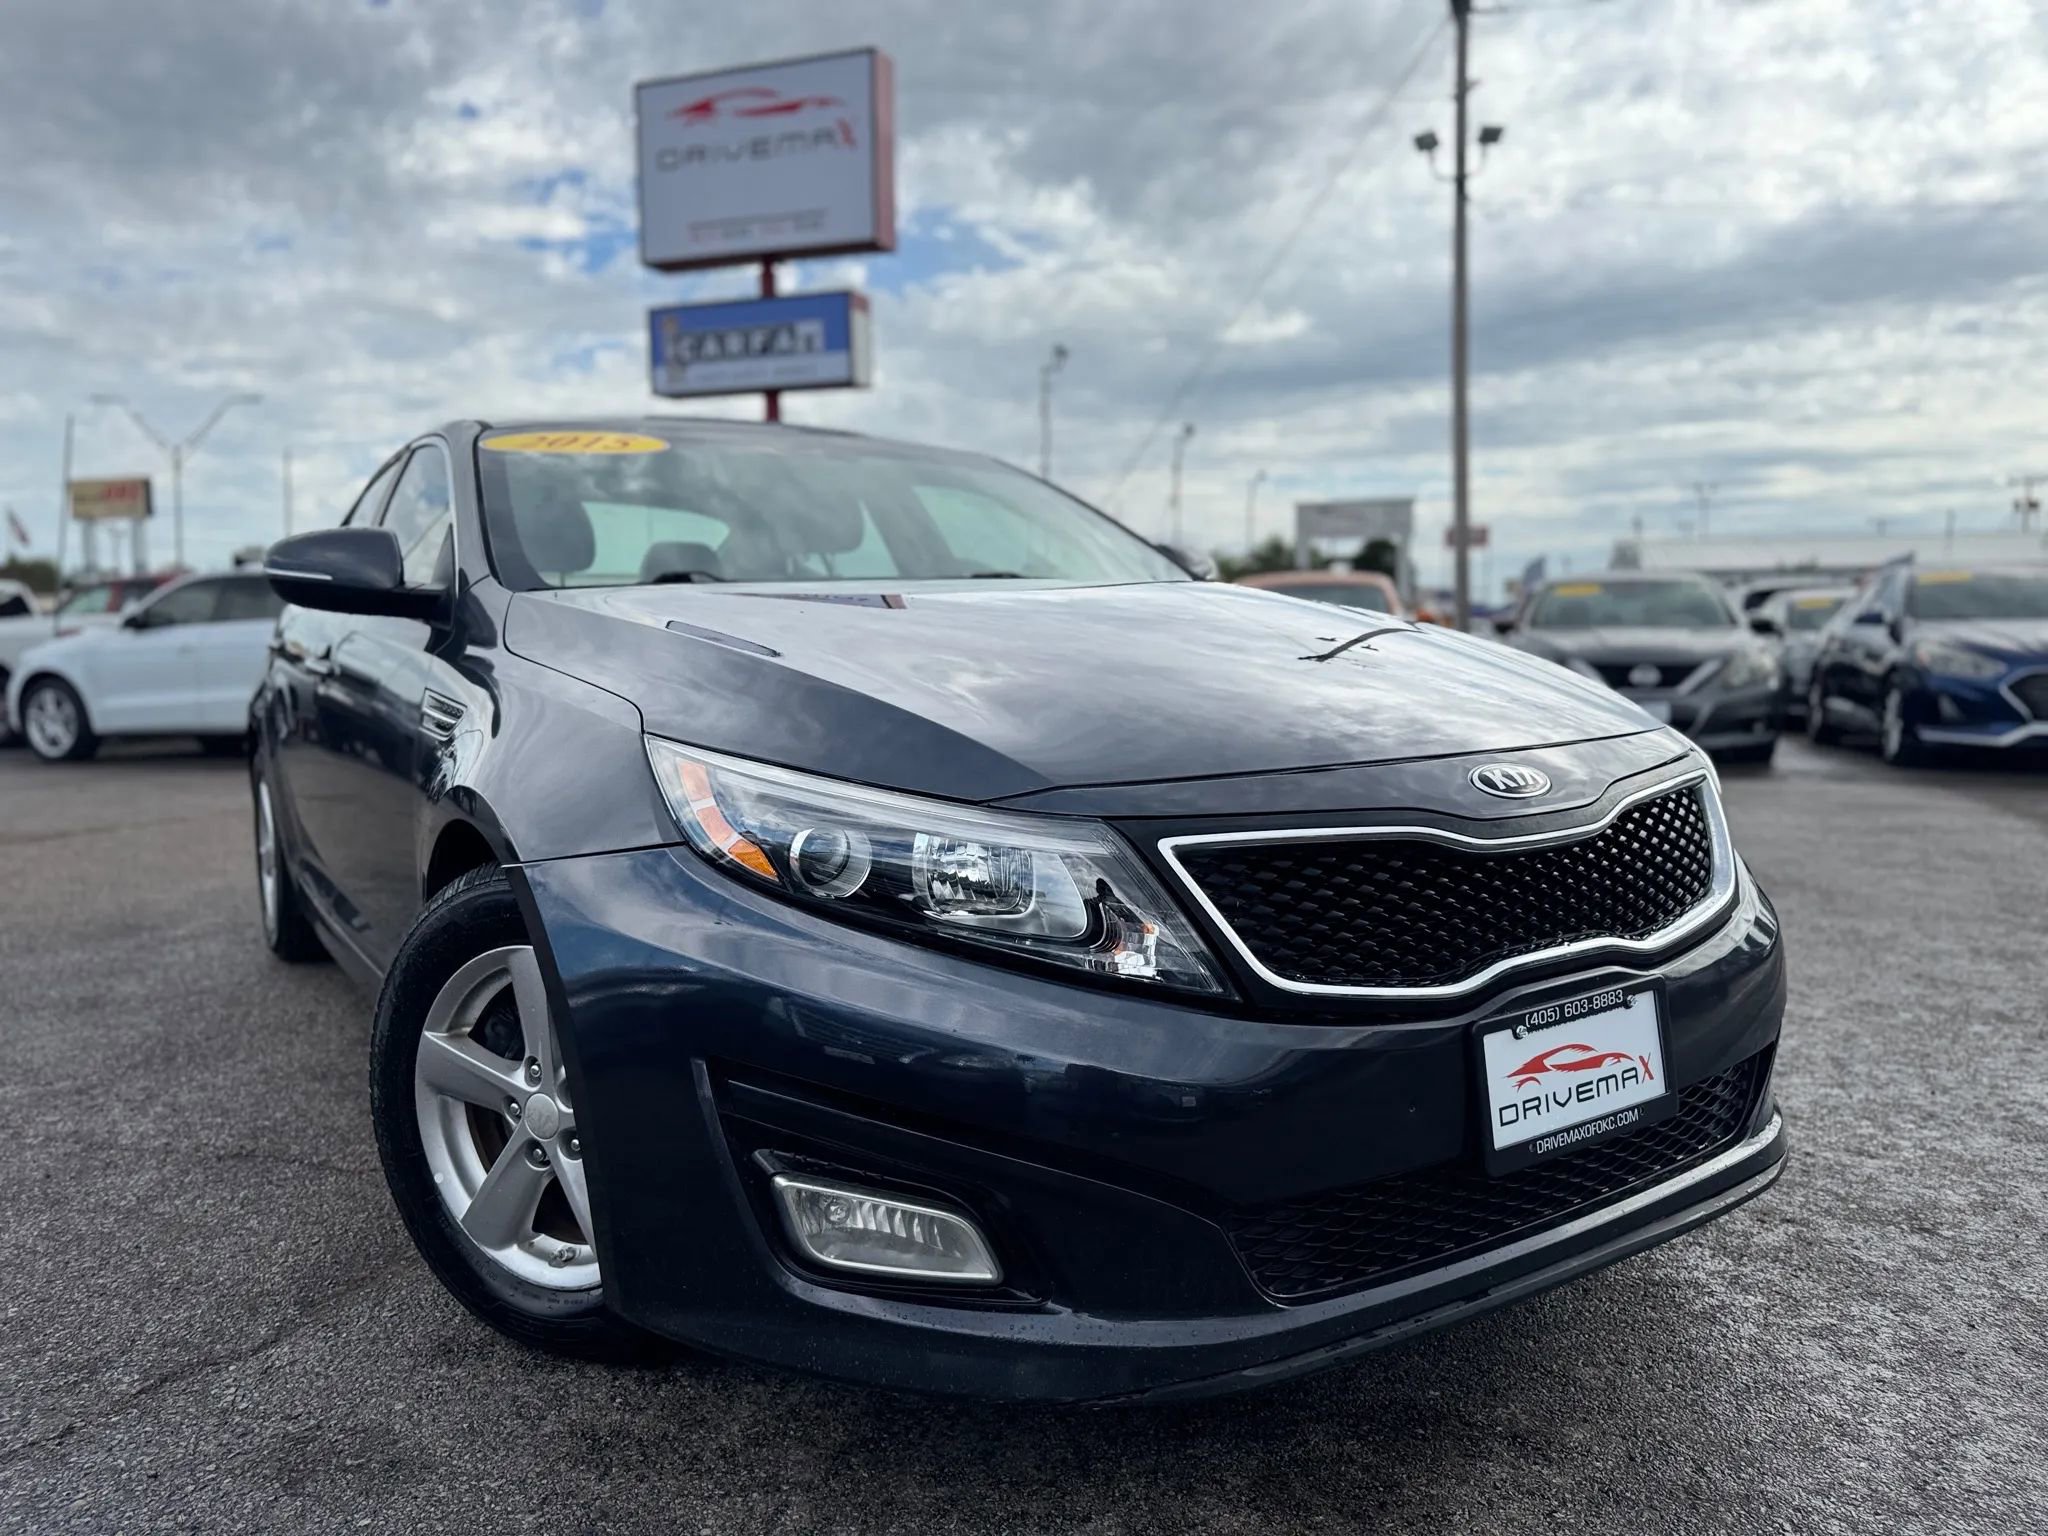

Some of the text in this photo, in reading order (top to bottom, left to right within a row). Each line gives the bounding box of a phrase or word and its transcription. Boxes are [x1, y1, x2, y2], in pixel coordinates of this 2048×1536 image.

[656, 119, 856, 172] DRIVEMAX
[1482, 766, 1543, 790] KIA
[1525, 989, 1624, 1028] (405) 603-8883
[1498, 1052, 1655, 1128] DRIVEMAX
[1536, 1108, 1640, 1155] DRIVEMAXOFOKC.COM
